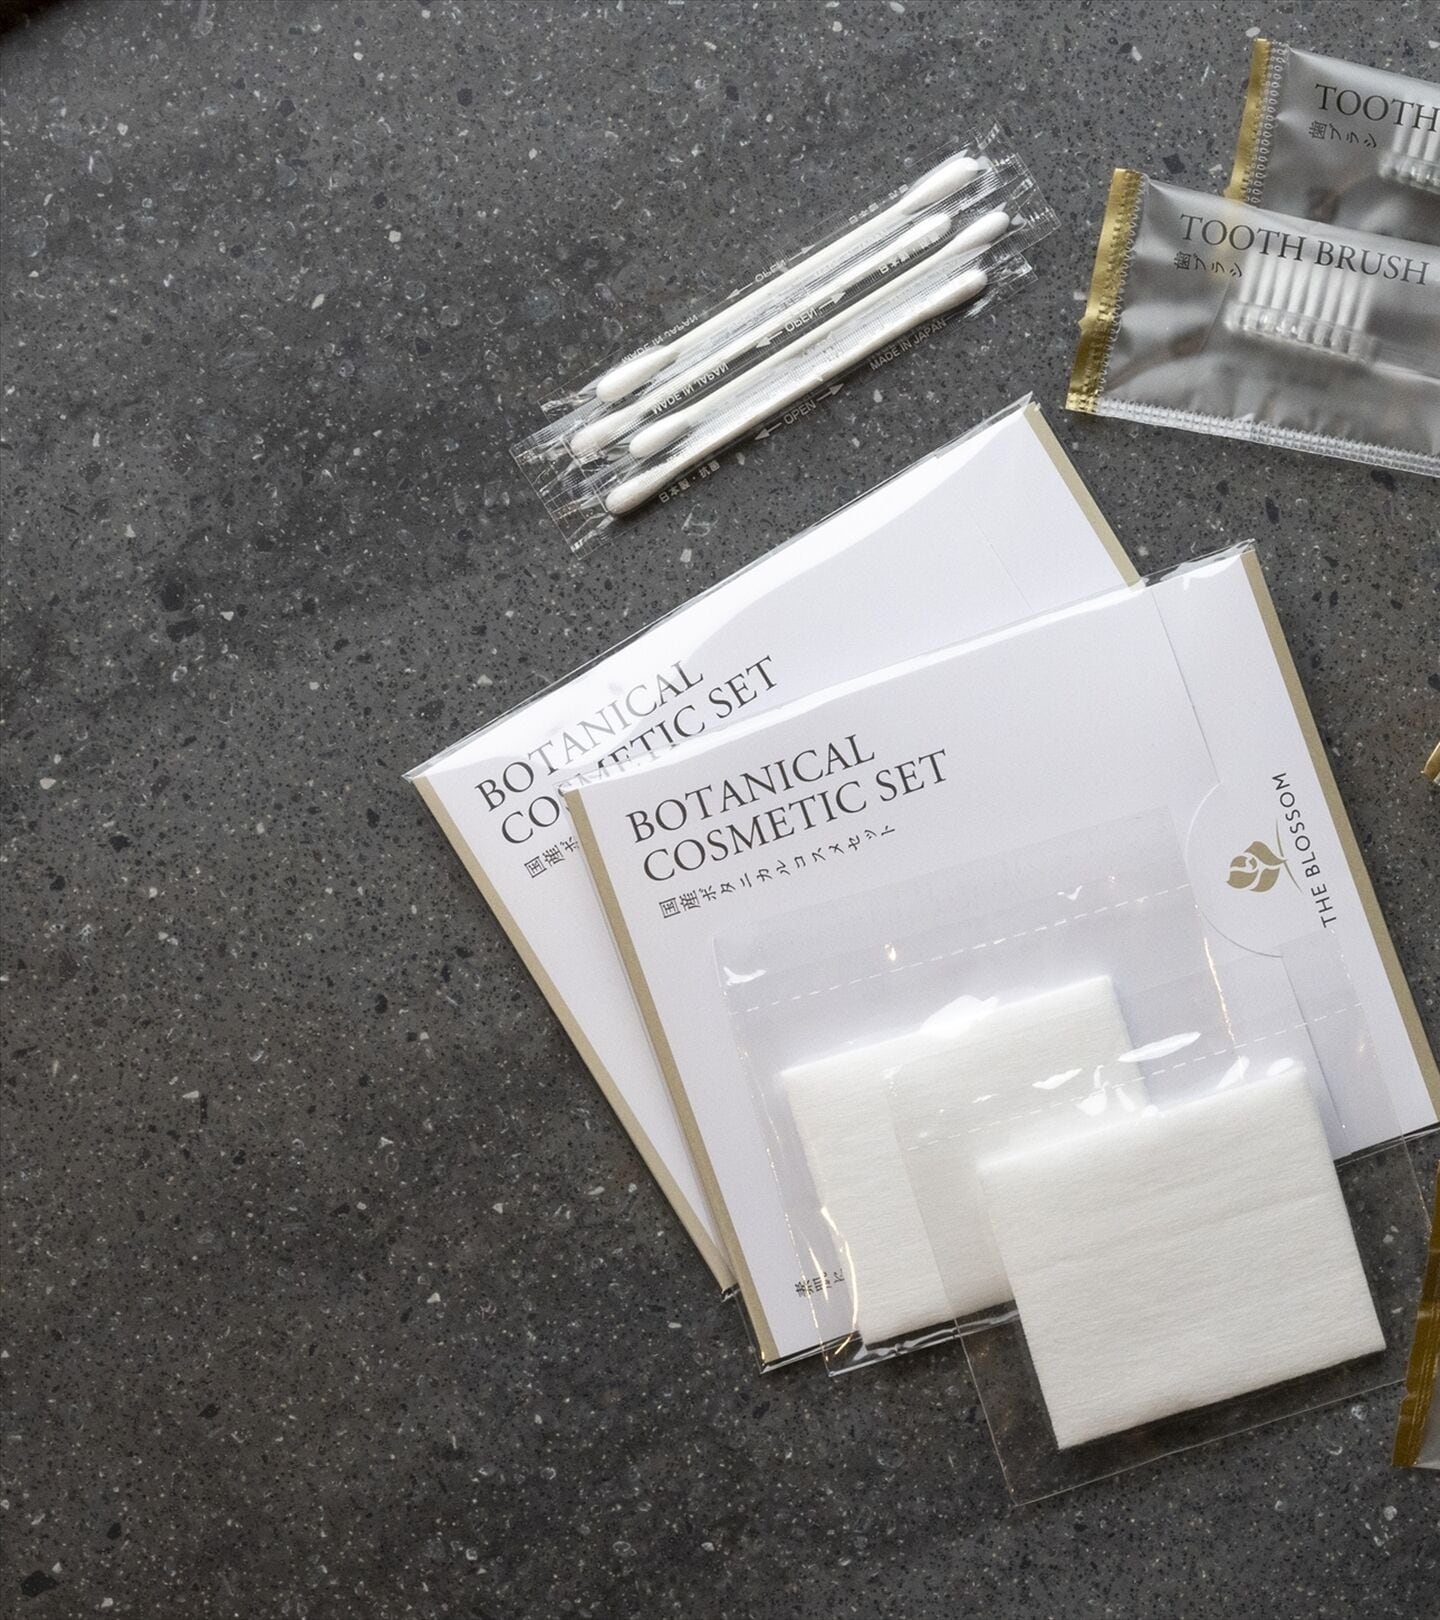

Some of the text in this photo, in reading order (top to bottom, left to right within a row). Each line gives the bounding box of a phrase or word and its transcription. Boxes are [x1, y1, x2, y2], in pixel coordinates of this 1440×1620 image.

[1308, 120, 1377, 150] 歯ブラシ
[1315, 84, 1440, 133] TOOTH
[1174, 251, 1243, 278] 歯ブラシ
[1180, 213, 1430, 285] TOOTH BRUSH
[868, 317, 948, 370] MADE IN JAPAN
[782, 398, 817, 425] OPEN
[708, 655, 777, 718] SET
[474, 661, 704, 811] BOTANICAL
[626, 733, 875, 843] BOTANICAL
[643, 749, 948, 882] COSMETIC SET
[659, 824, 896, 919] 国産ボタニカルコスメセット
[1272, 772, 1337, 928] THE BLOSSOM
